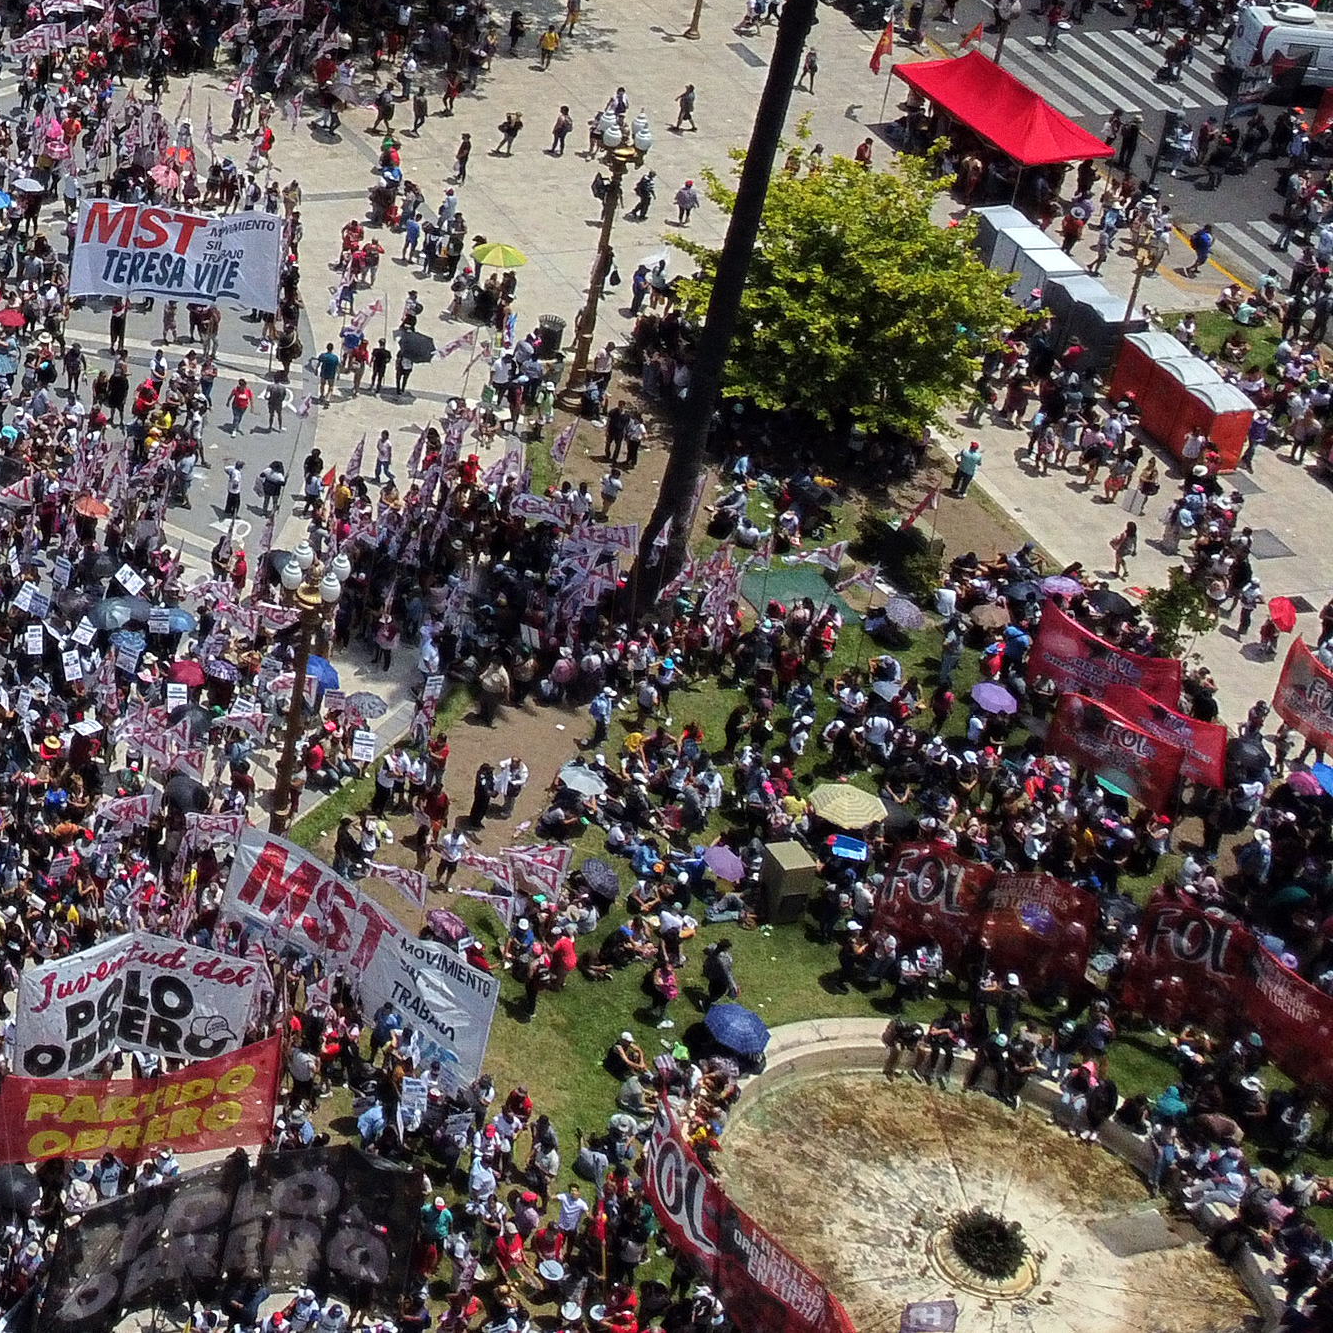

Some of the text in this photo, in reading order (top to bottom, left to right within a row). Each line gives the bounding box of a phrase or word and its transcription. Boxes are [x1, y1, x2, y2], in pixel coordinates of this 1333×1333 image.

[82, 202, 209, 257] MST
[102, 249, 187, 289] TERESA
[237, 840, 398, 970] MST
[883, 849, 969, 916] FOL
[400, 936, 491, 998] MOVIMIENTO
[1144, 908, 1234, 977] FOL
[31, 945, 255, 1014] Juventud del
[65, 971, 195, 1040] POLO
[23, 1016, 236, 1078] OBRERO
[26, 1064, 256, 1125] PARTIDO
[26, 1100, 243, 1157] OBRERO
[752, 1228, 812, 1284] FRENTE
